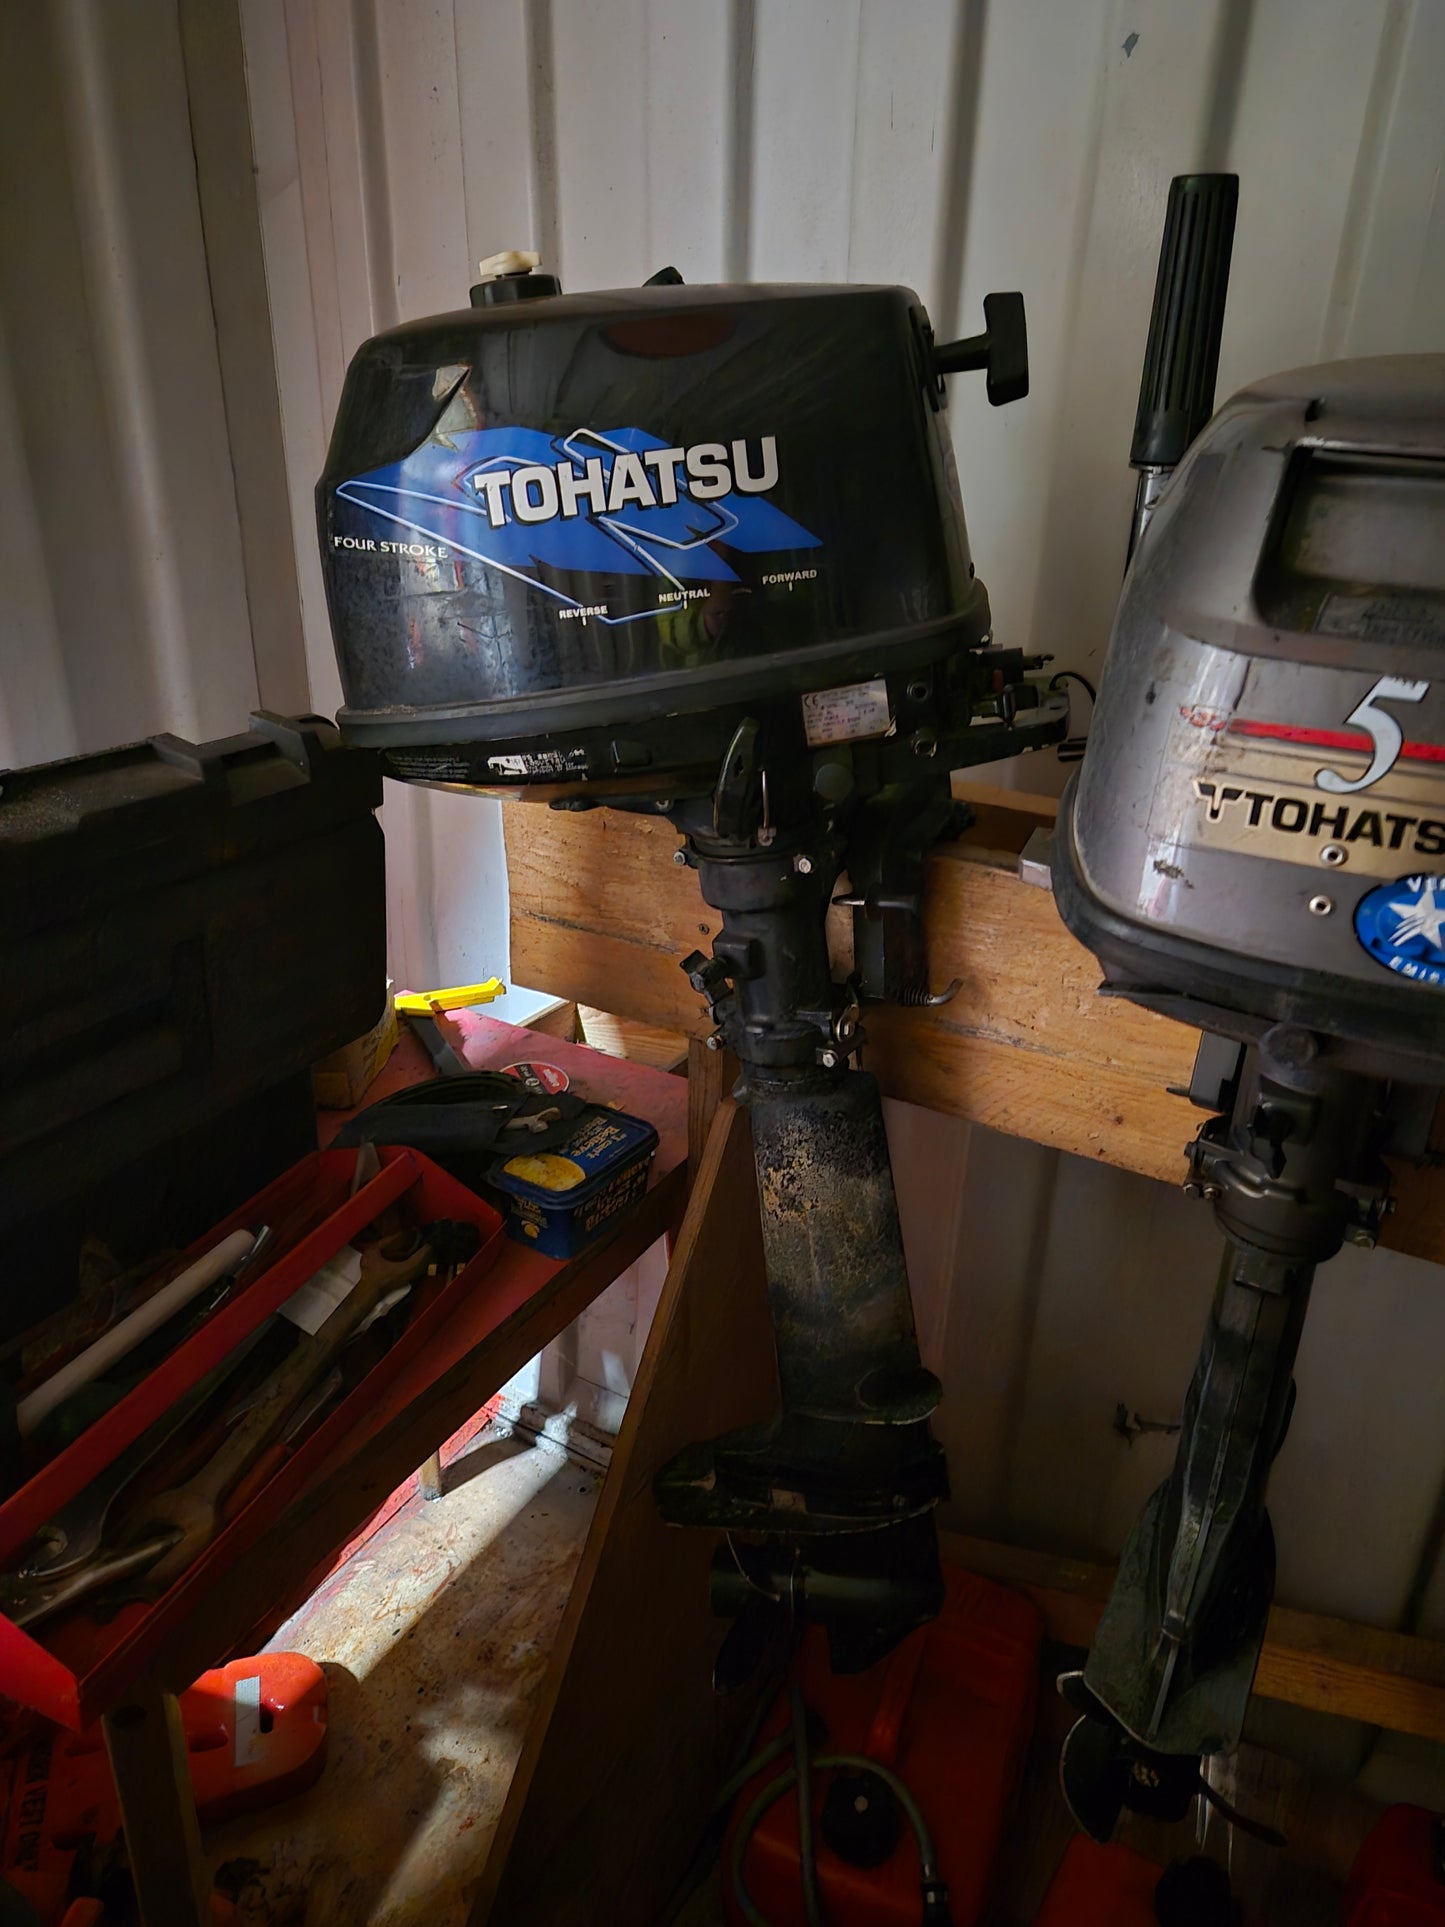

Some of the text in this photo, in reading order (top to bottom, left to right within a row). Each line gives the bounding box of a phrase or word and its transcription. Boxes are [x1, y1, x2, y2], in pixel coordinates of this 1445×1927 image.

[473, 435, 779, 527] TOHATSU
[333, 535, 449, 559] FOUR STROKE
[761, 569, 818, 585] FORWARD
[658, 588, 711, 603] NEUTRAL
[558, 605, 609, 620] REVERSE
[1313, 675, 1431, 795] 5
